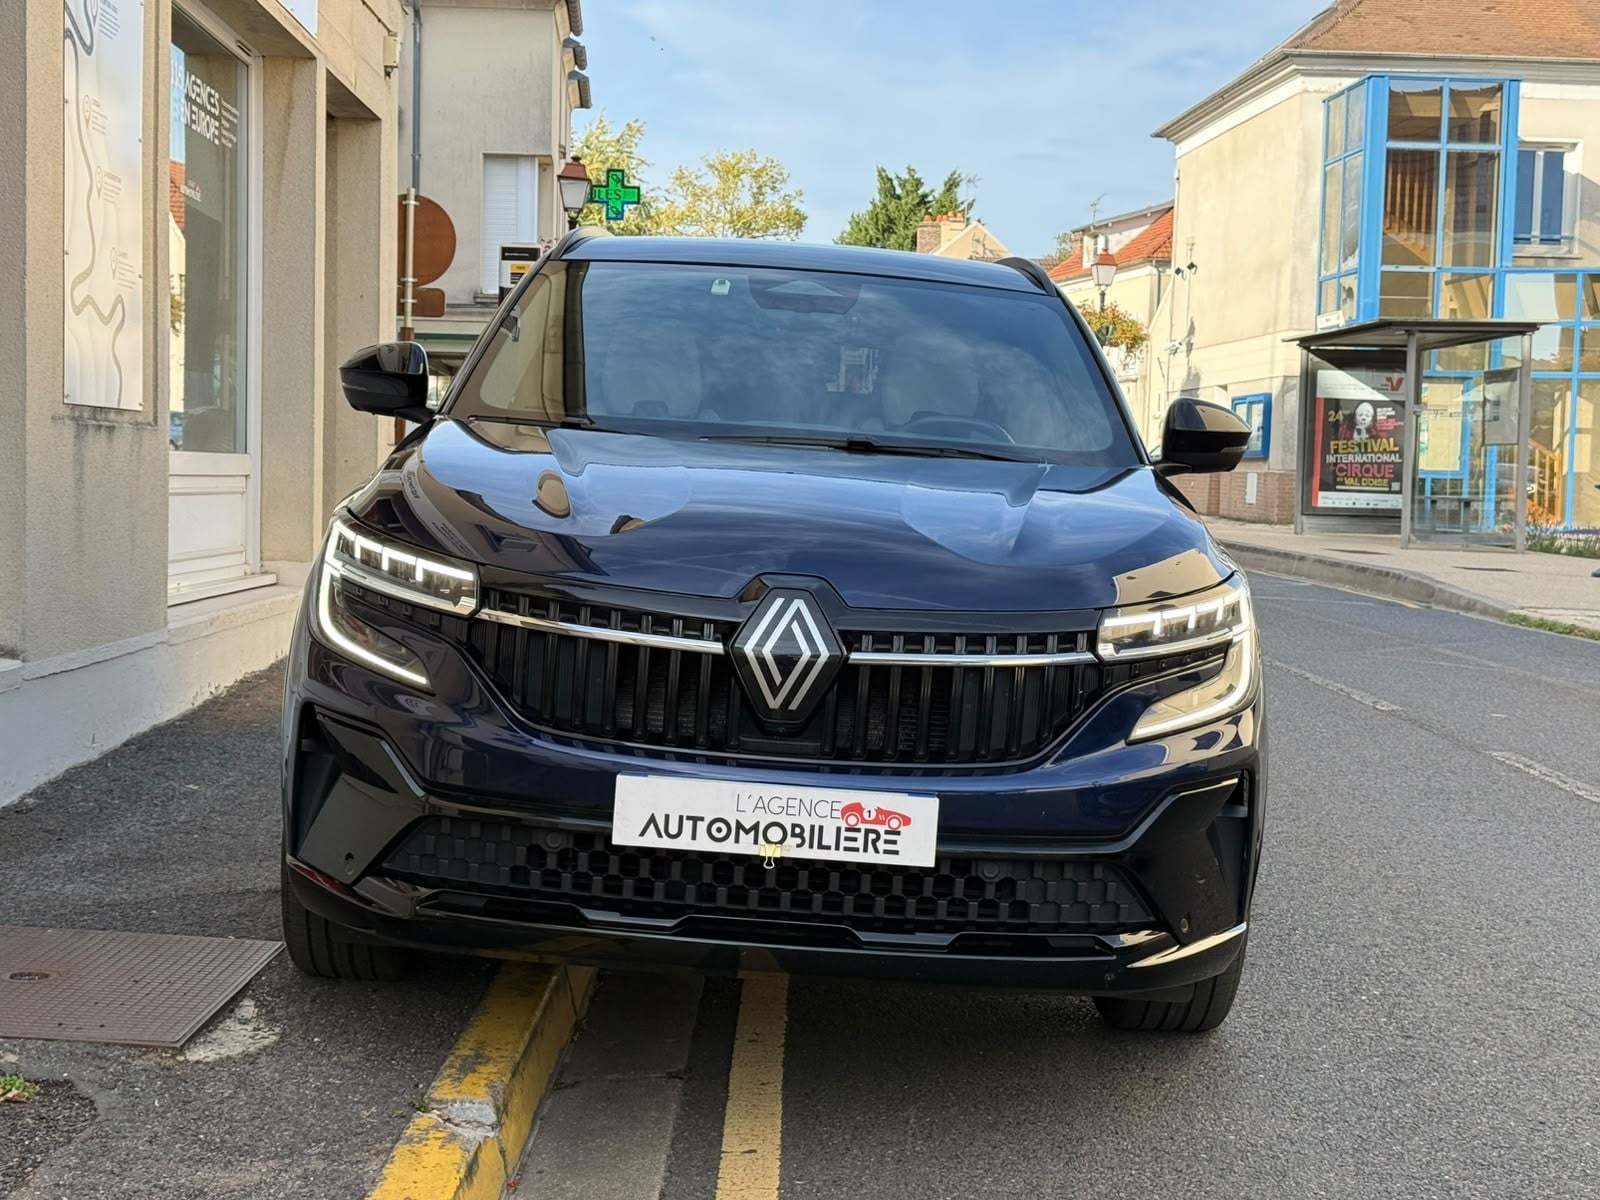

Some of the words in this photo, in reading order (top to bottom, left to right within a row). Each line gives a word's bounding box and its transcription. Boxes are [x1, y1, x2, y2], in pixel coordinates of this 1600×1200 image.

[184, 71, 219, 116] AGENCES
[191, 104, 220, 146] EUROPE
[1329, 437, 1399, 454] FESTIVAL
[1326, 453, 1402, 463] INTERNATIONAL
[1335, 463, 1394, 478] CIRQUE
[1344, 477, 1360, 486] VAL
[736, 793, 842, 820] L'AGENCE
